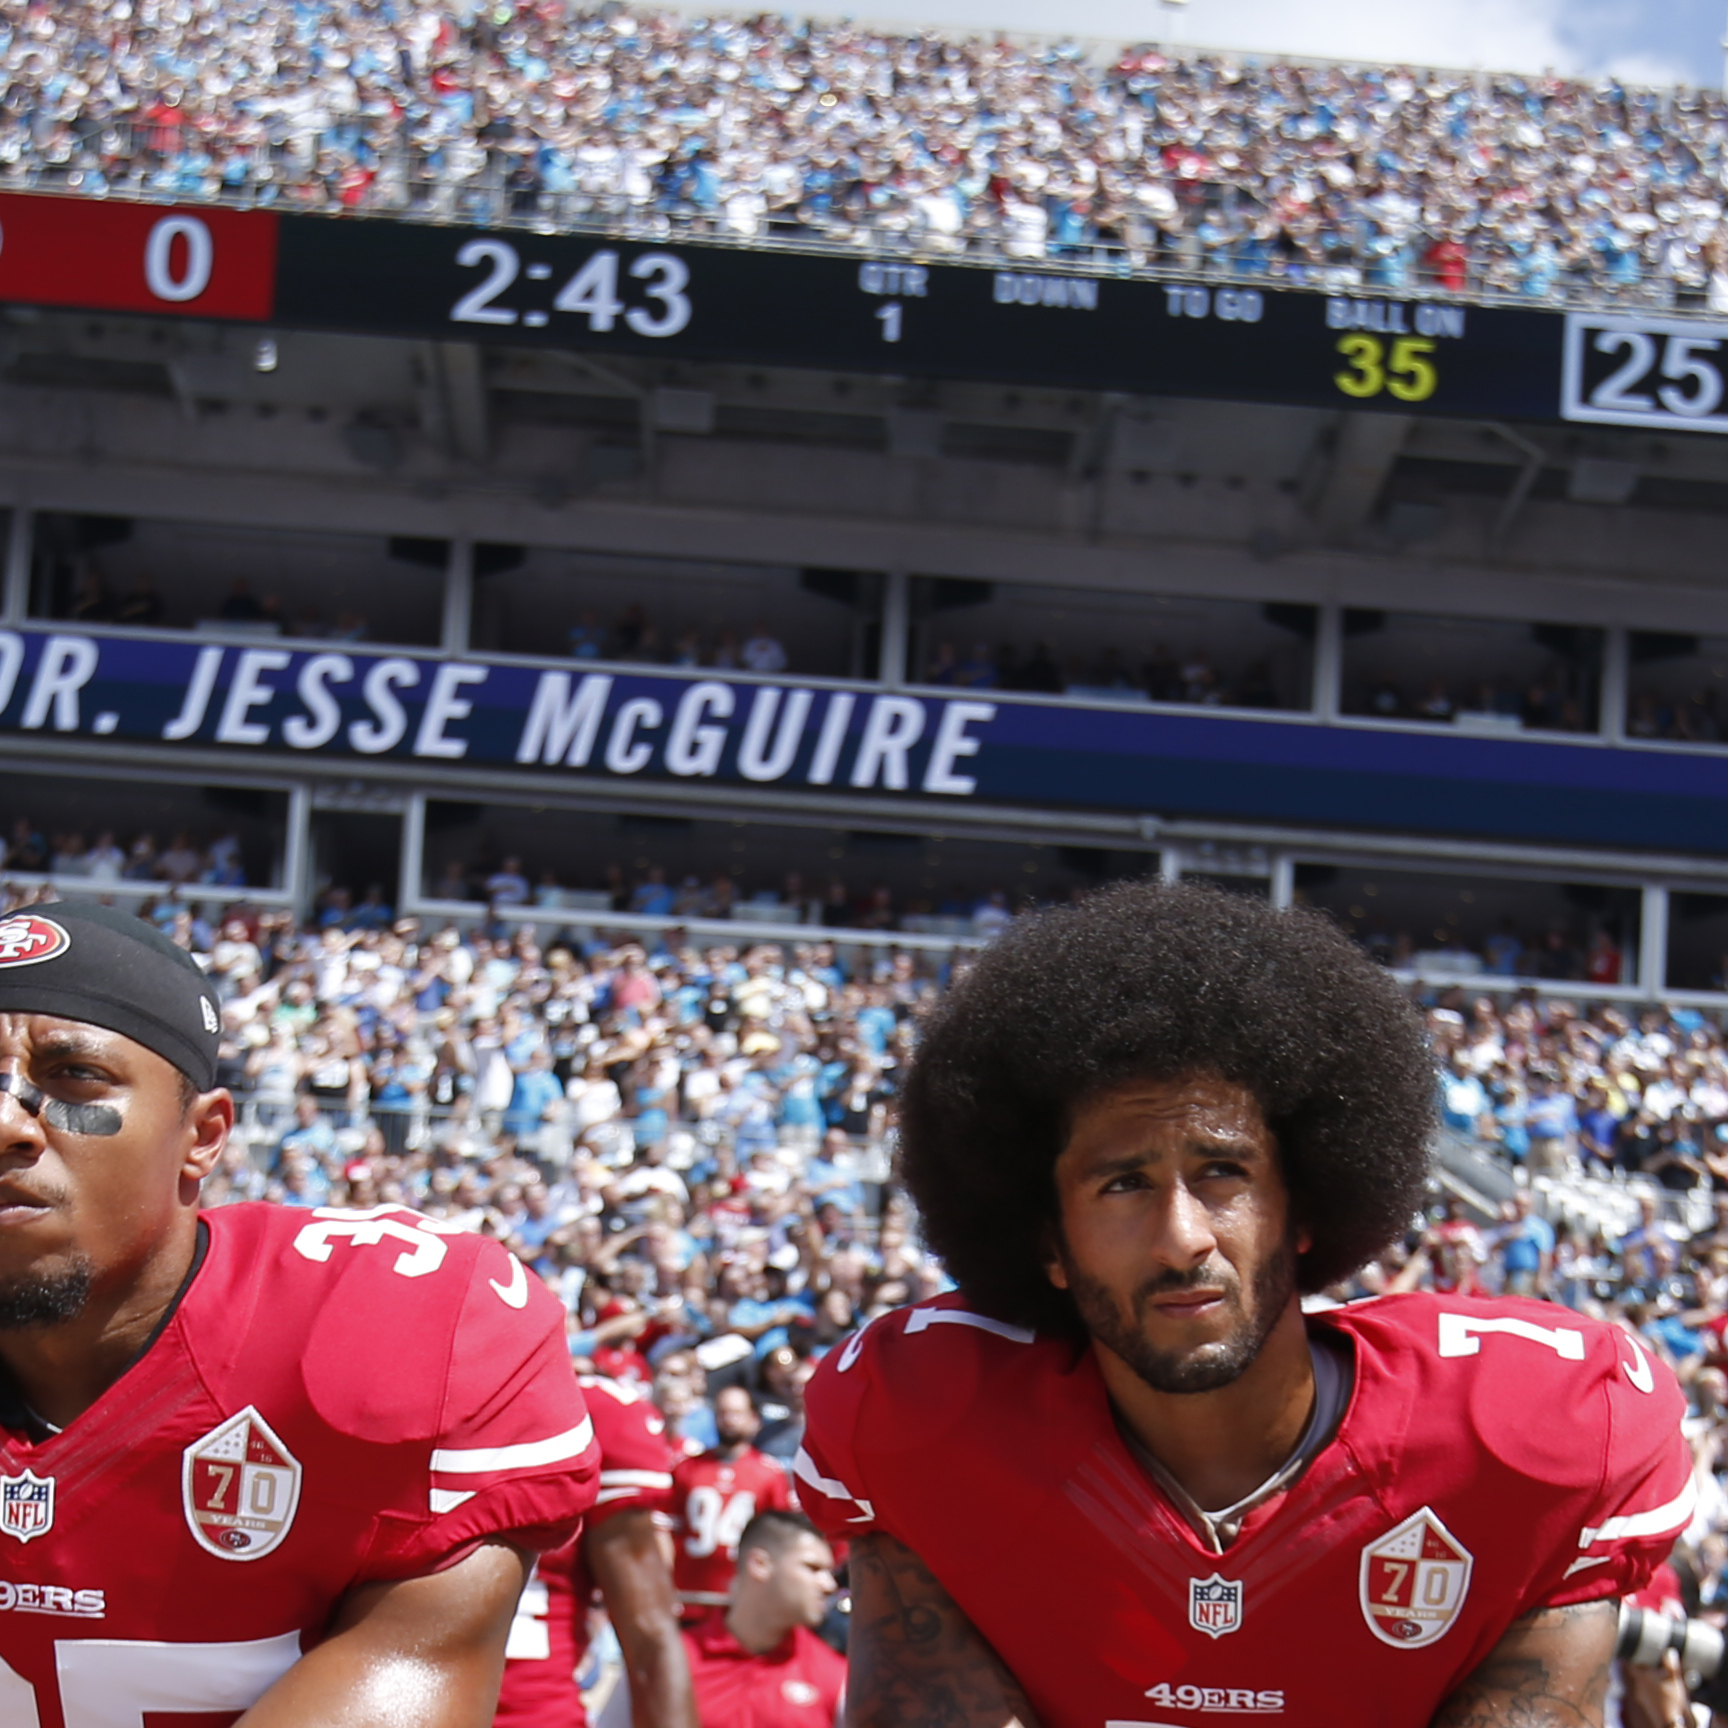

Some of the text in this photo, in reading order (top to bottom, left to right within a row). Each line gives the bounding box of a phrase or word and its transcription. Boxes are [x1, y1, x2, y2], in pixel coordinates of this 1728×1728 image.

[144, 214, 214, 301] 0
[450, 238, 693, 337] 2:43
[857, 260, 929, 298] QTR
[875, 301, 904, 342] 1
[1162, 284, 1210, 318] TO
[1325, 298, 1465, 339] BALL ON
[1334, 332, 1438, 402] 35
[1588, 331, 1725, 418] 25
[162, 644, 490, 760] JESSE
[515, 669, 997, 796] McGUIRE
[206, 1464, 277, 1515] 70
[8, 1501, 46, 1529] NFL
[210, 1514, 266, 1529] YEARS
[1381, 1562, 1450, 1606] 70
[1197, 1602, 1234, 1627] NFL
[1384, 1607, 1438, 1619] YEARS
[1144, 1682, 1285, 1713] 49ERS
